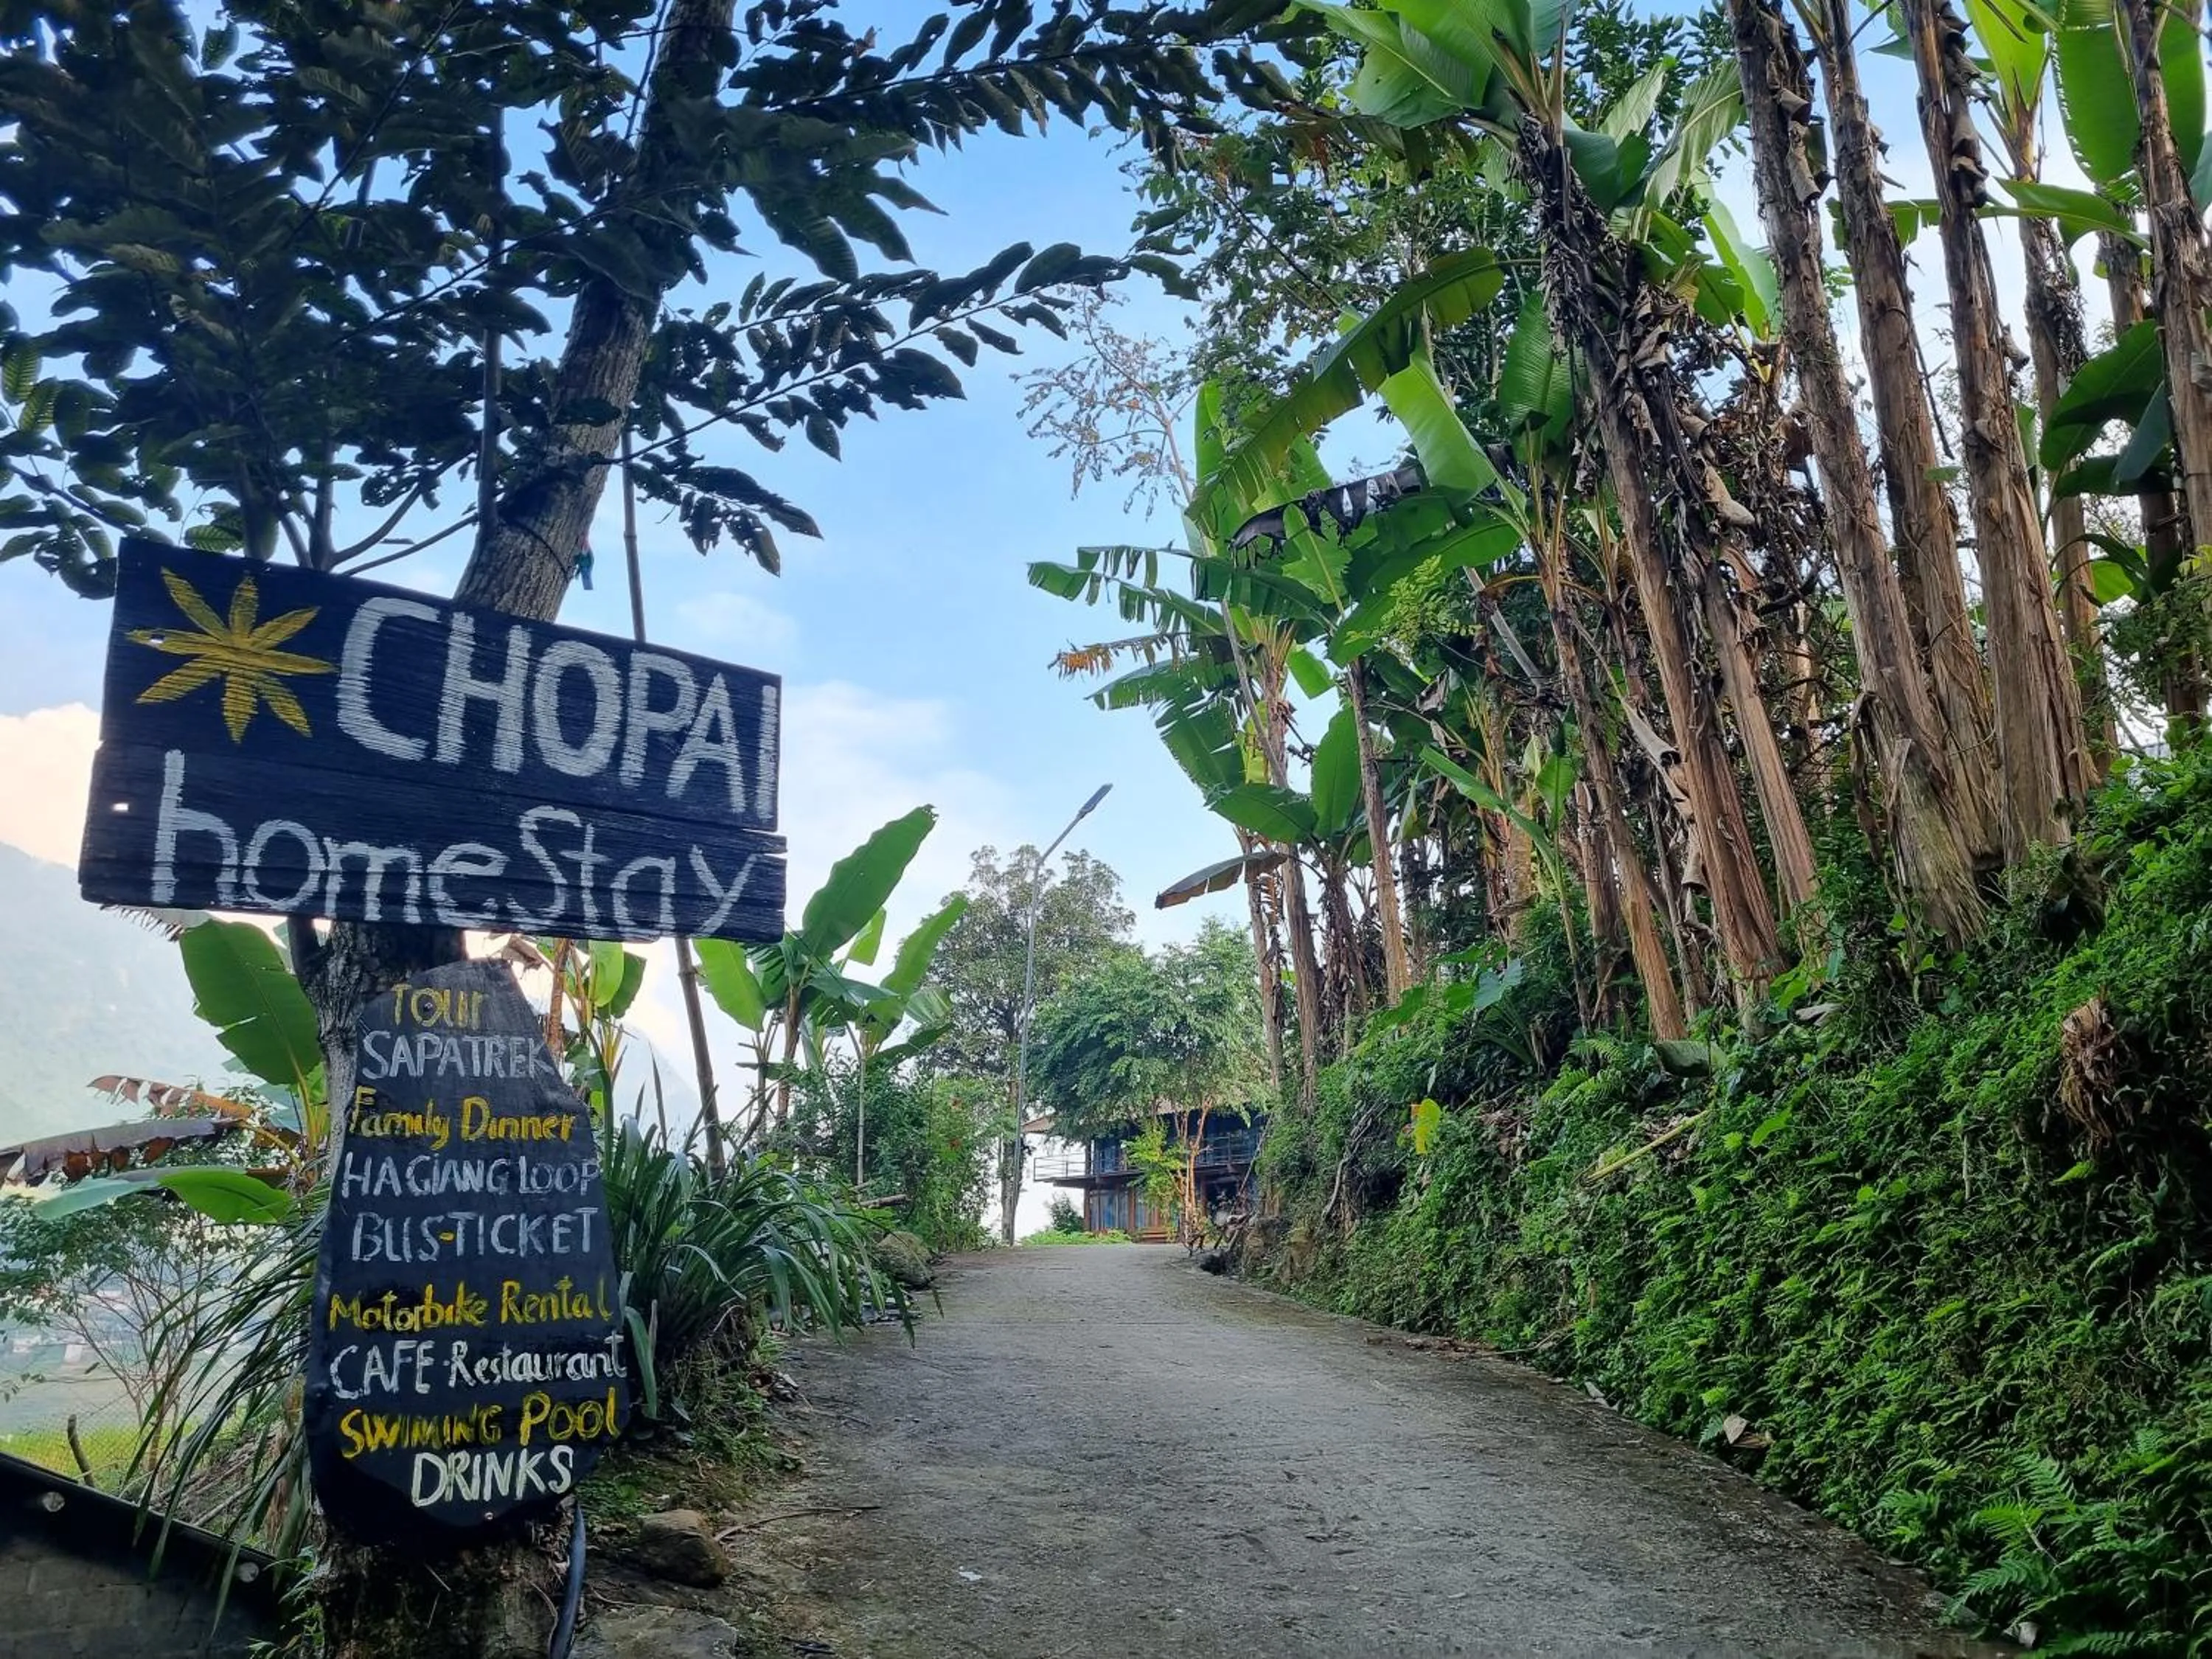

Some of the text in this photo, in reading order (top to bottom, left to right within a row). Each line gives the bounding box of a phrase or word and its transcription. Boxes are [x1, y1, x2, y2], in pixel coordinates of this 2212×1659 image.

[335, 596, 778, 820] CHOPAI
[519, 1155, 600, 1196] LOOP
[499, 1275, 613, 1324] Rental
[411, 1444, 574, 1507] DRINKS
